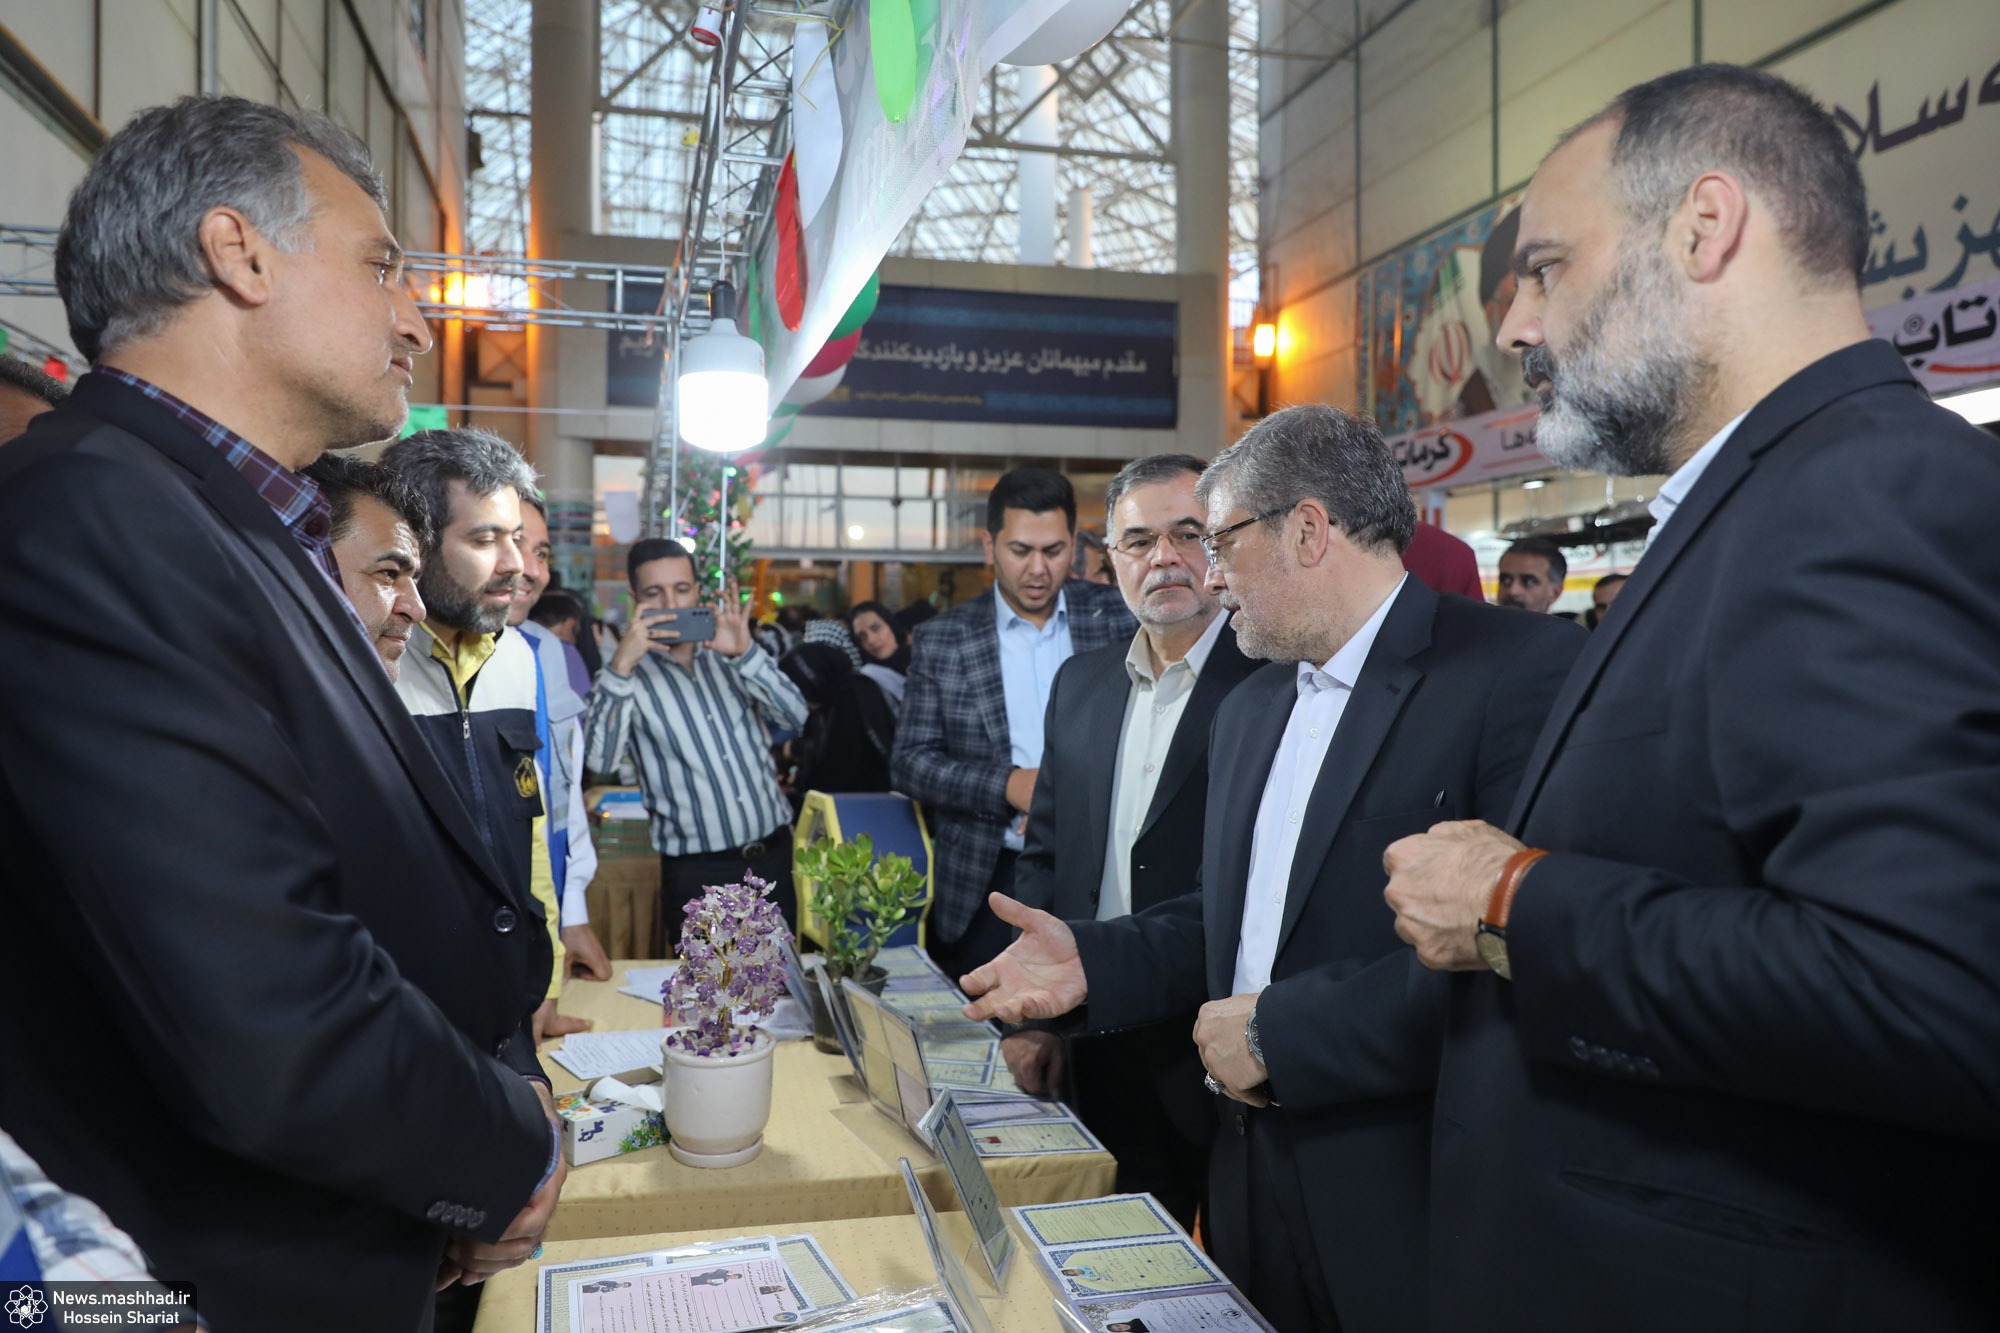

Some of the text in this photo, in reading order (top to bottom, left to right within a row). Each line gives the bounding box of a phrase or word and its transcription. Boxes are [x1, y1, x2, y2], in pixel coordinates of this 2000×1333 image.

[1893, 296, 2000, 368] تاب
[965, 351, 977, 371] و
[980, 348, 1022, 373] عزیز
[1103, 350, 1147, 380] مقدم
